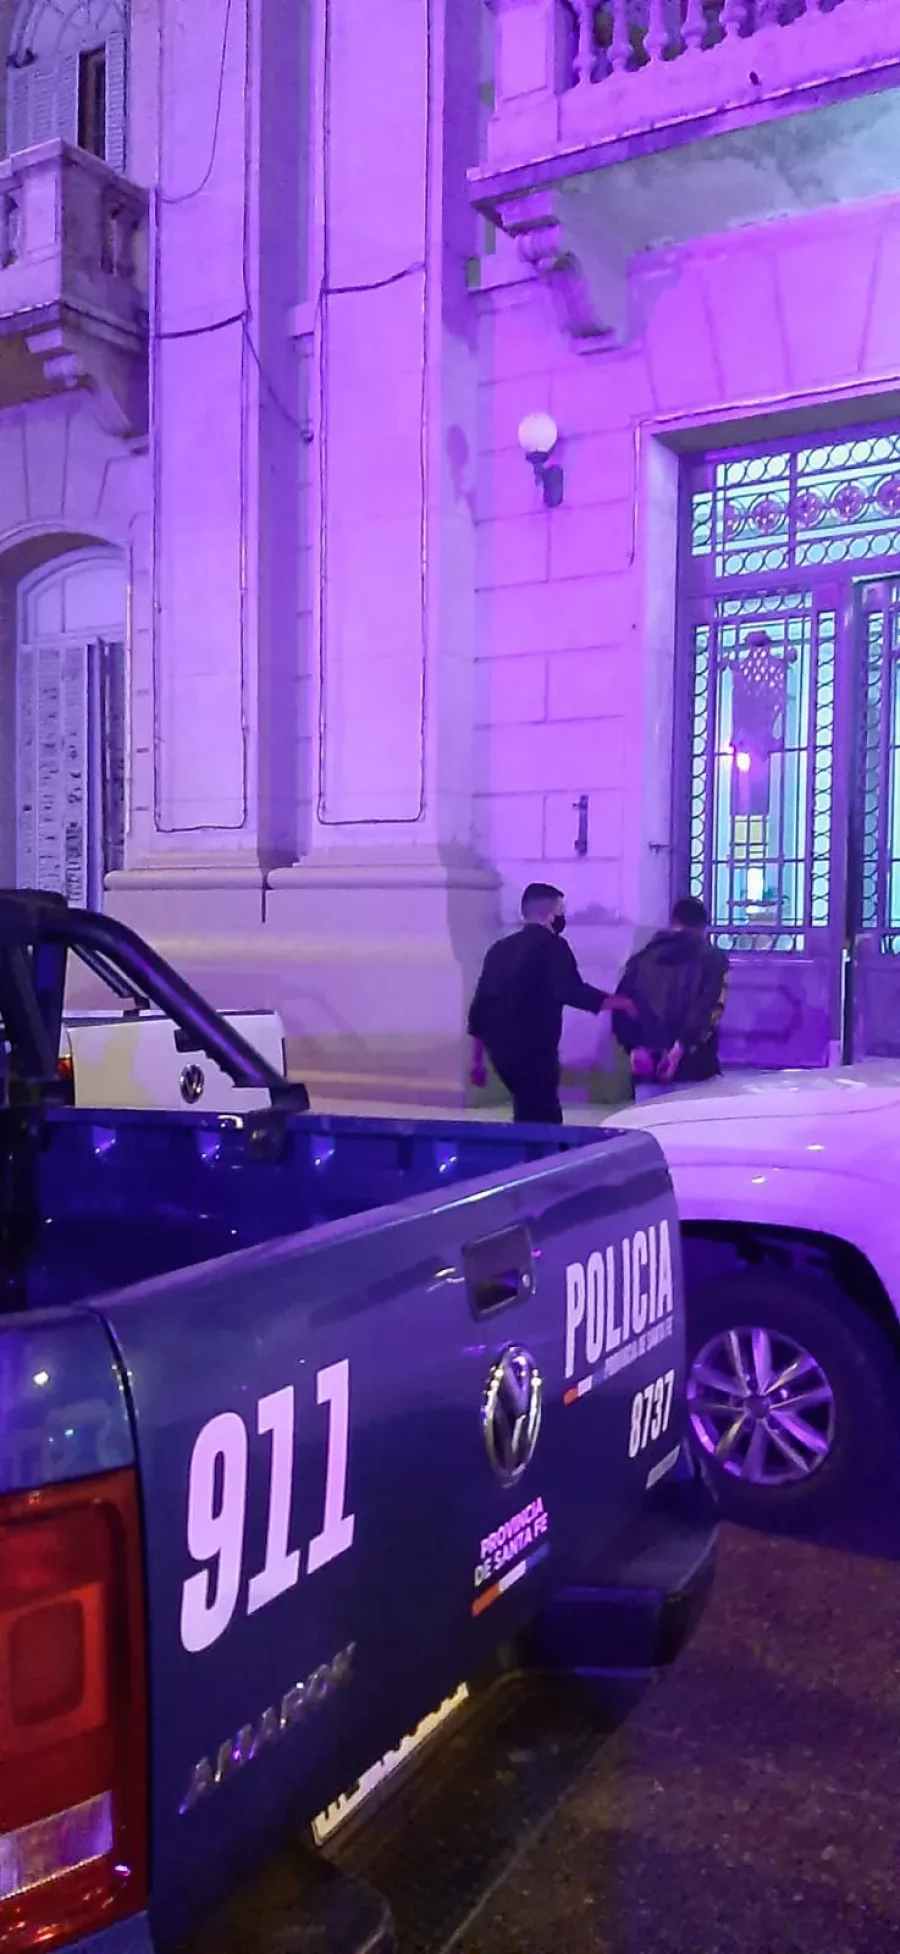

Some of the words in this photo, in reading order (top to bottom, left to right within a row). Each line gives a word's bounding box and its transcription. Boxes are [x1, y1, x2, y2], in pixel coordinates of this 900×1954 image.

[565, 1219, 674, 1379] POLICIA
[628, 1369, 675, 1458] 8737
[180, 1358, 355, 1653] 911
[474, 1557, 491, 1586] DE
[494, 1526, 532, 1570] SANTA
[534, 1512, 548, 1538] FE
[480, 1496, 543, 1559] PROVINCIA
